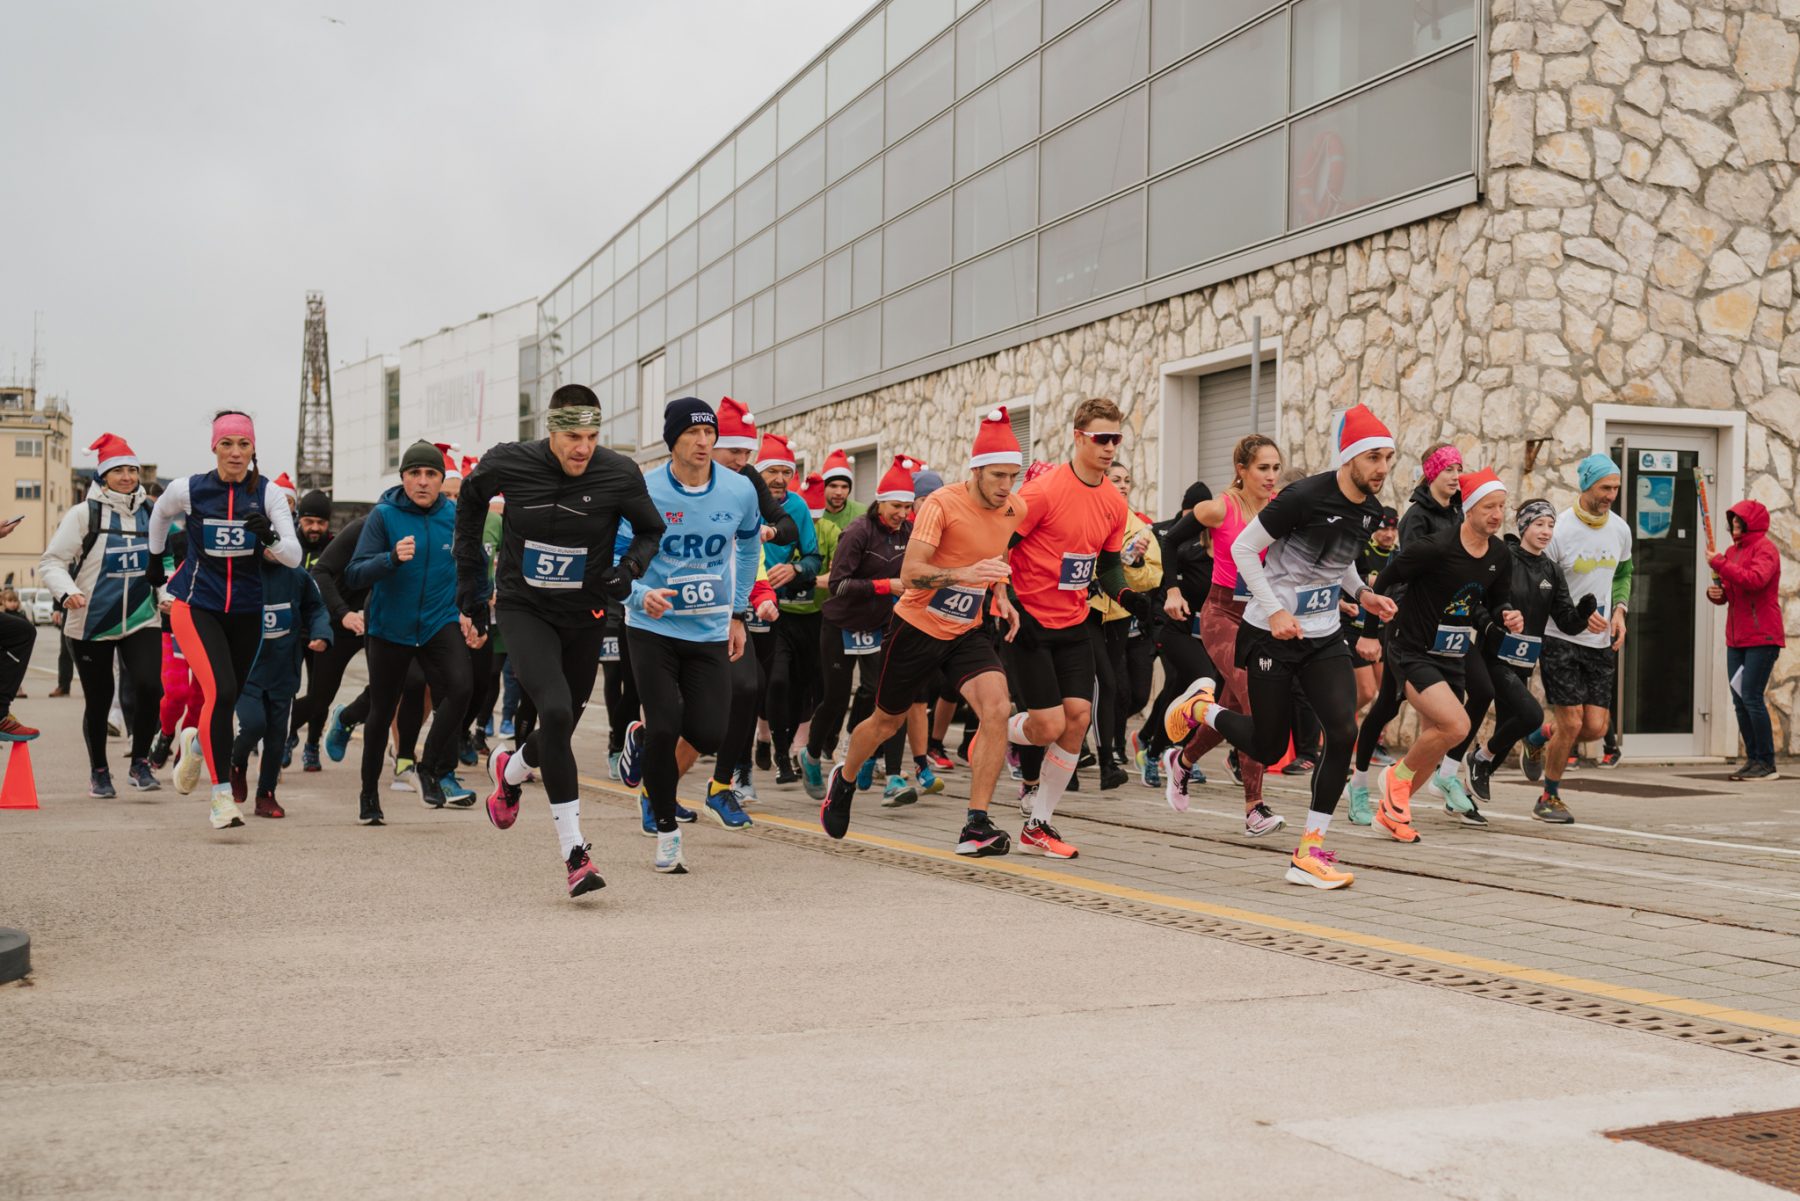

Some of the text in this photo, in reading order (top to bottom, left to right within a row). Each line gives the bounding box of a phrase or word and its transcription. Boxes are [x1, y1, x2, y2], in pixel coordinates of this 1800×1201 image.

[691, 415, 715, 423] RIVAL
[215, 527, 245, 546] 53
[662, 533, 727, 559] CRO
[118, 552, 138, 568] 11
[536, 553, 573, 576] 57
[1071, 561, 1092, 579] 38
[682, 582, 715, 604] 66
[1306, 589, 1331, 610] 43
[944, 593, 973, 613] 40
[264, 612, 277, 628] 9
[851, 631, 874, 646] 16
[1446, 633, 1464, 650] 12
[603, 642, 620, 654] 18
[1515, 641, 1529, 657] 8
